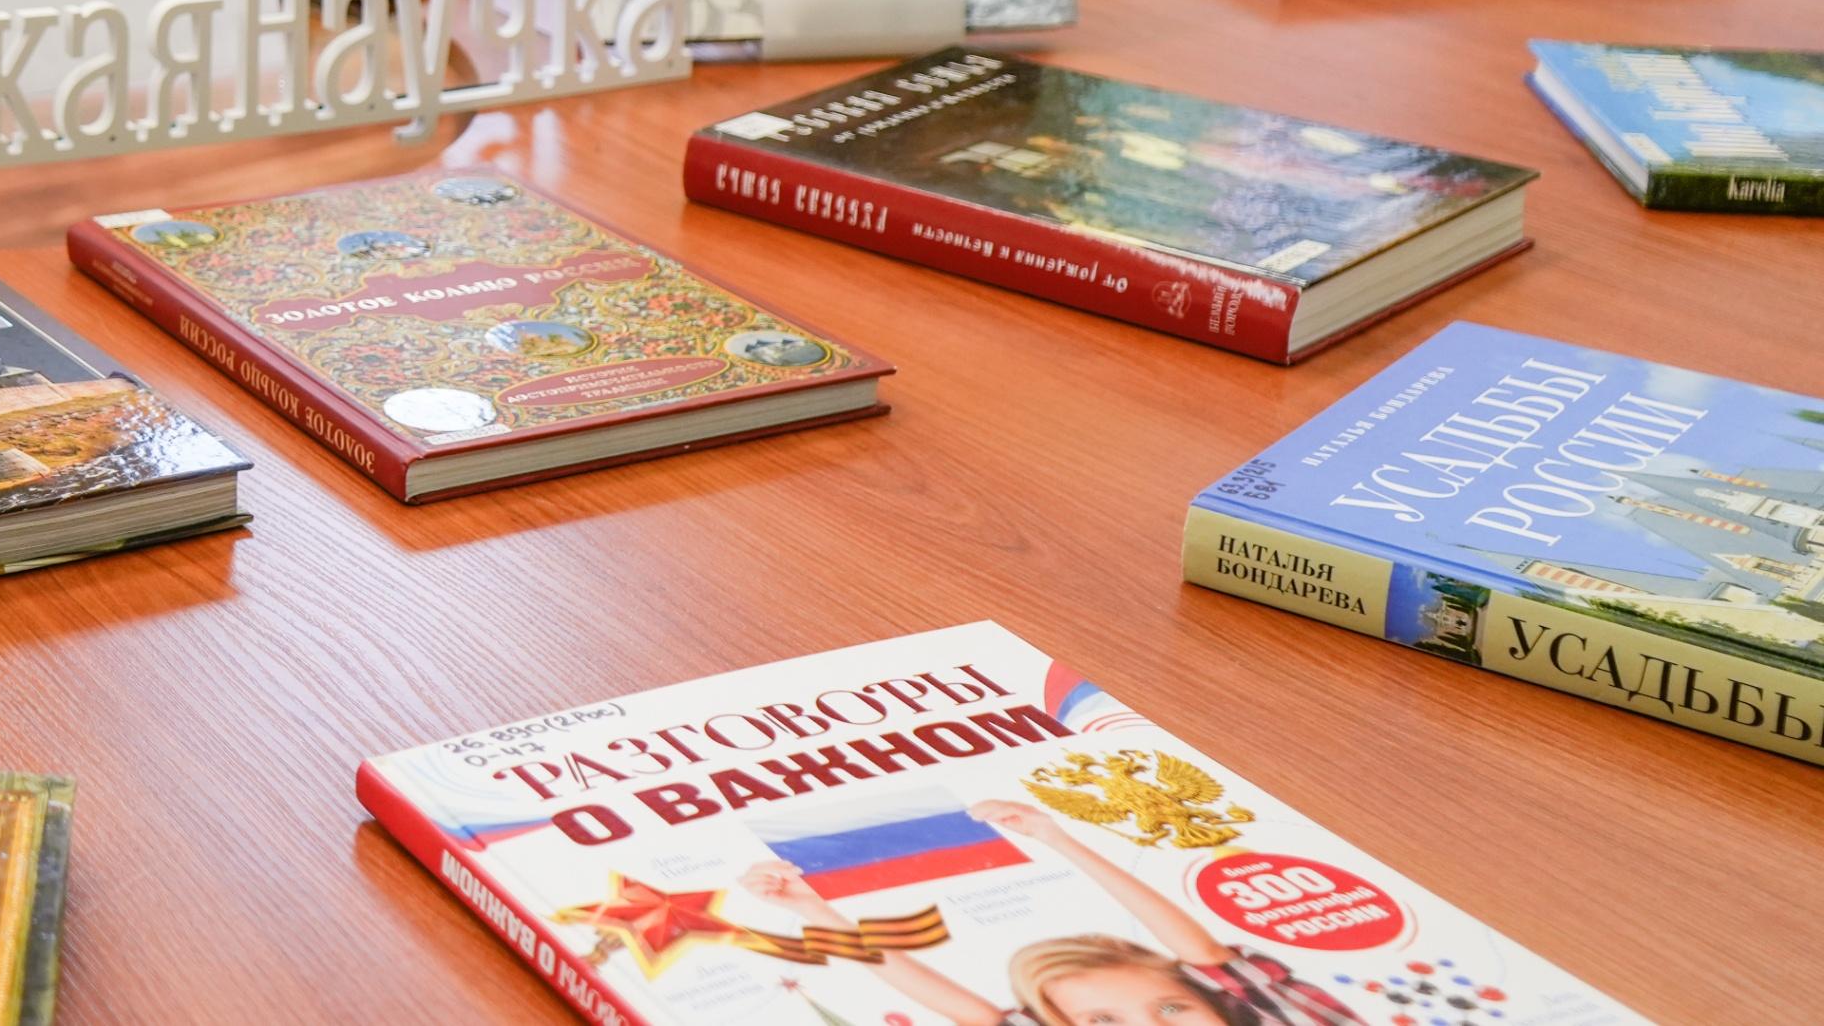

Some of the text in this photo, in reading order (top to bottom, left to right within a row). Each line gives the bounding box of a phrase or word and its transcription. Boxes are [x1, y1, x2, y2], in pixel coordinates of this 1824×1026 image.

[794, 184, 889, 235] РУССКАЯ
[265, 256, 643, 326] ЗОЛОТОЕ КОЛЬЦО РОССИИ
[179, 313, 376, 474] ЗОЛОТОЕ КОЛЬЦО РОССИИ
[1301, 366, 1456, 468] НАТАЛЬЯ БОНДАРЕВА
[1331, 357, 1607, 523] УСАДЬБЫ
[1464, 391, 1709, 548] РОССИИ
[1216, 557, 1367, 617] БОНДАРЕВА
[1218, 533, 1335, 584] НАТАЛЬЯ
[492, 662, 1018, 803] РАЗГОВОРЫ
[550, 703, 1077, 847] О ВАЖНОМ
[441, 848, 537, 958] ВАЖНОМ
[1216, 865, 1337, 910] 300
[1243, 885, 1379, 927] фотографий
[1274, 903, 1391, 941] РОССИИ
[537, 941, 556, 976] О
